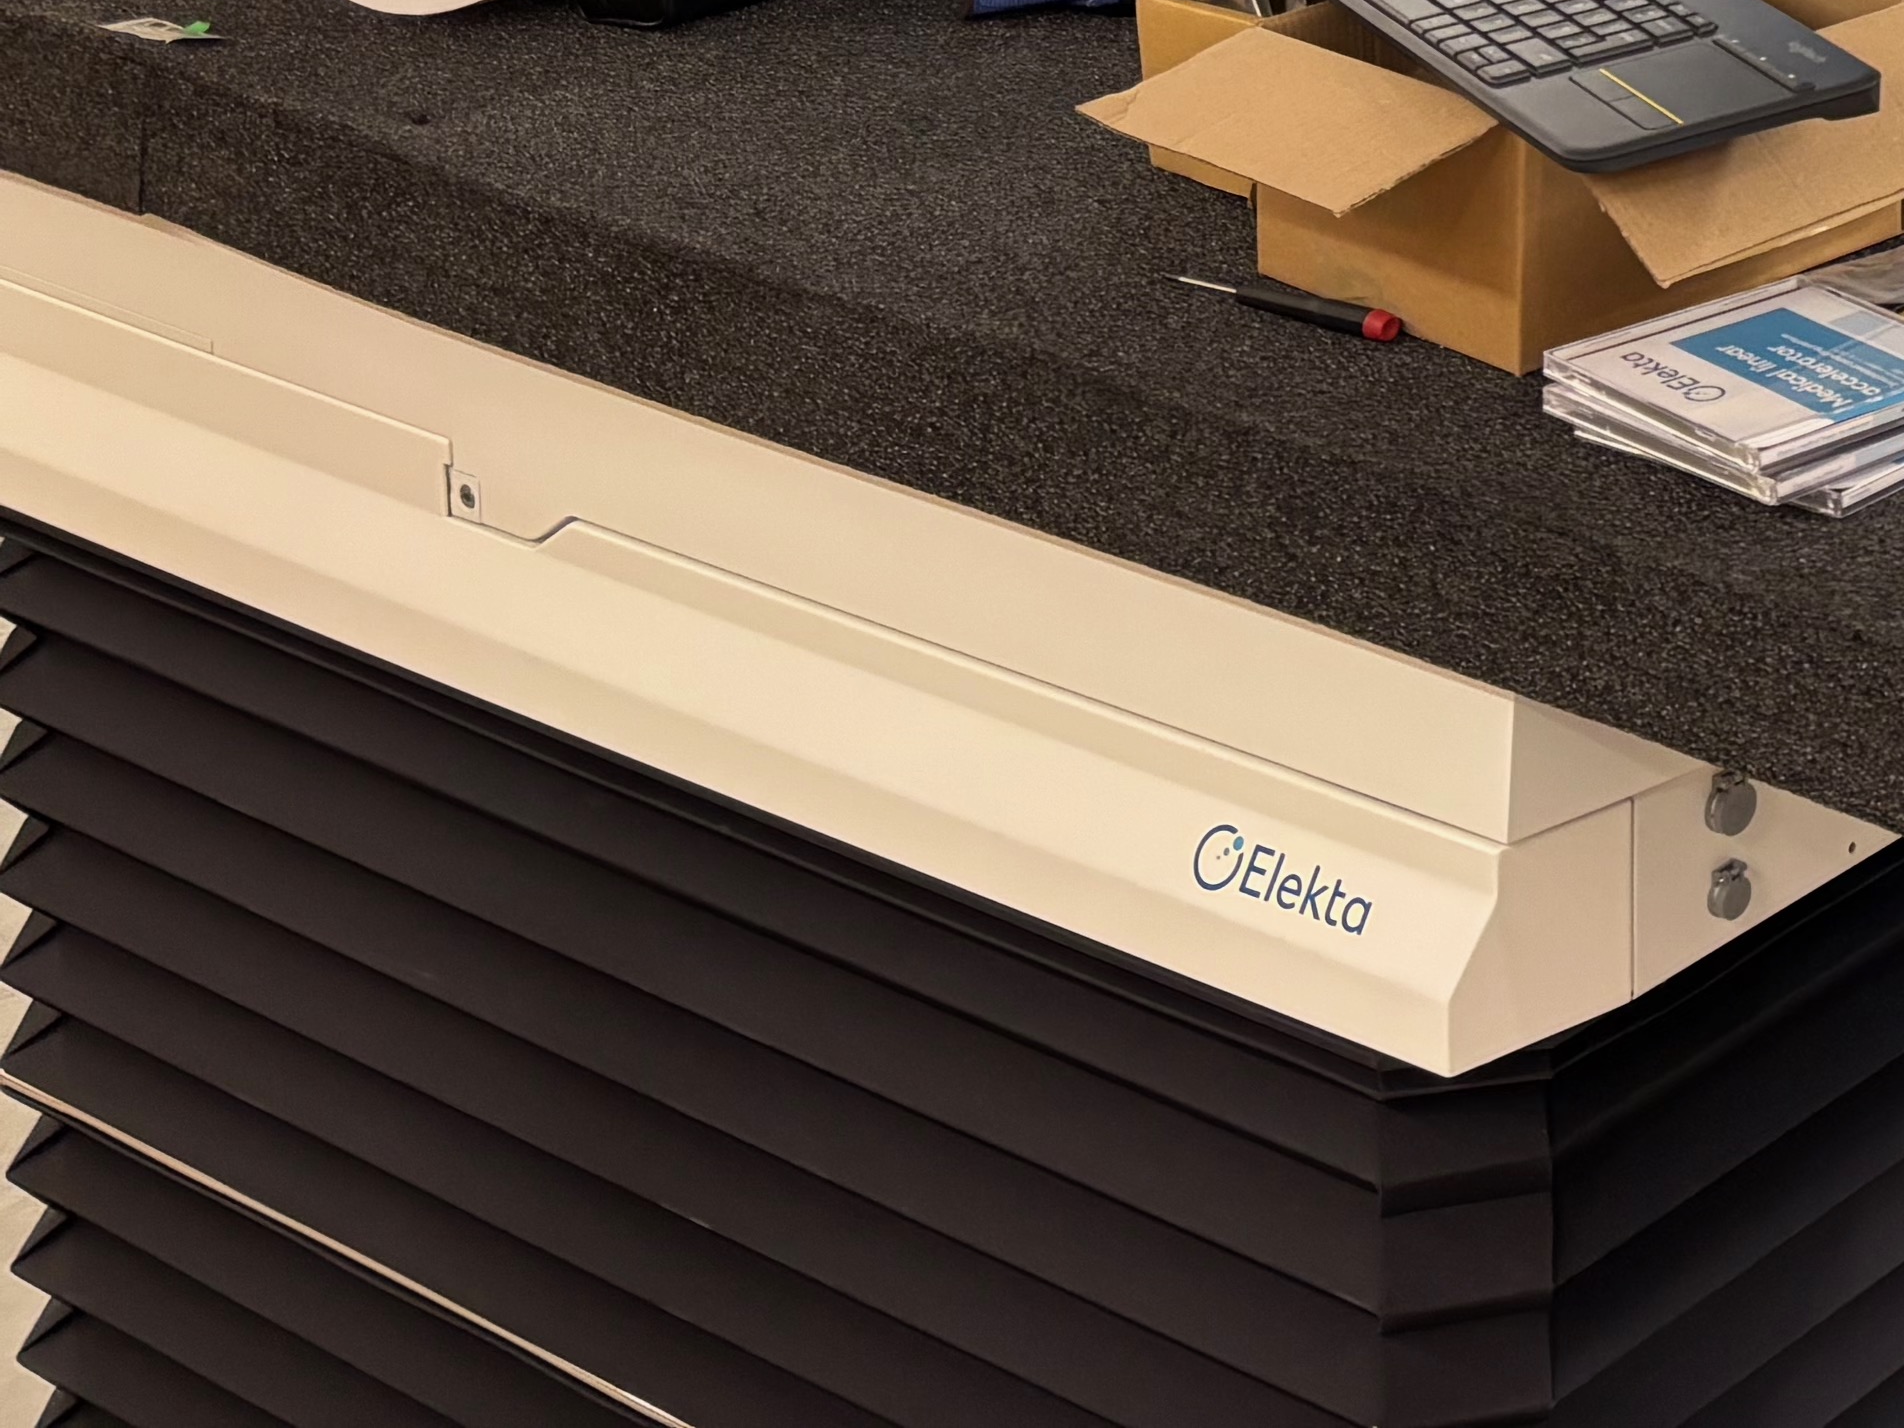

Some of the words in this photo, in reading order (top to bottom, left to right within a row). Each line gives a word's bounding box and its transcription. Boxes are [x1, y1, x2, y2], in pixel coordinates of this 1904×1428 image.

[1620, 351, 1701, 392] Elekta
[1715, 345, 1777, 374] linear
[1767, 343, 1882, 399] accelerator
[1768, 368, 1854, 409] Medical
[1238, 843, 1373, 936] Elekta
